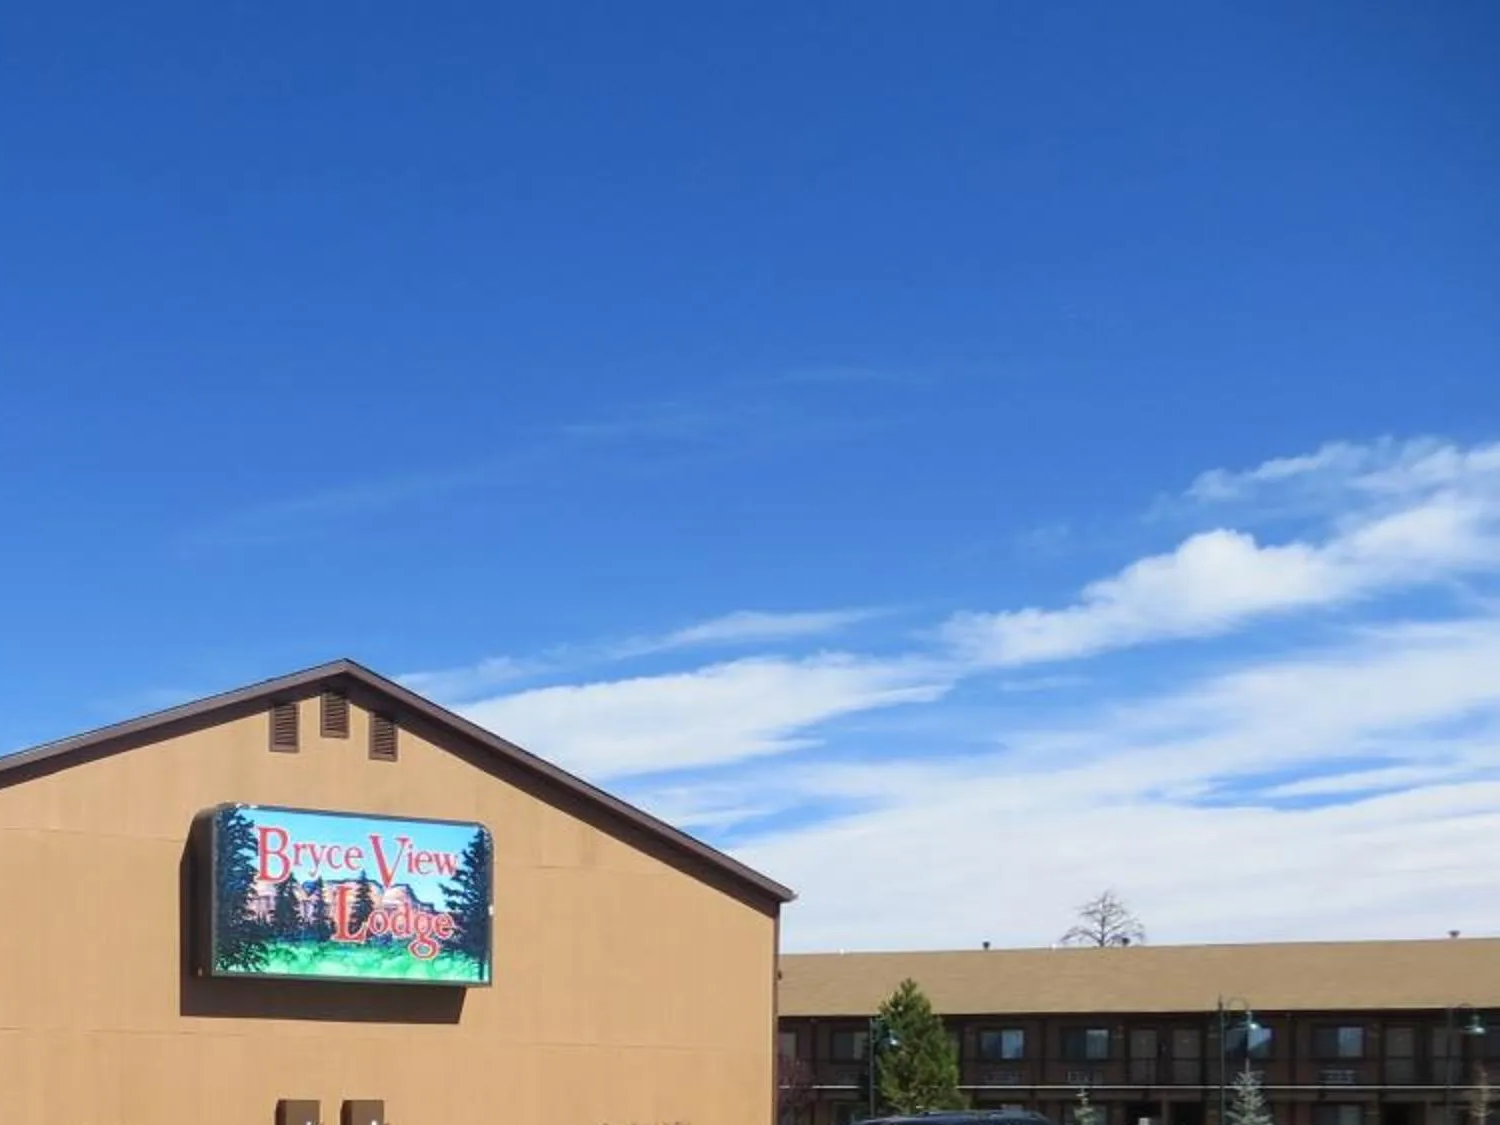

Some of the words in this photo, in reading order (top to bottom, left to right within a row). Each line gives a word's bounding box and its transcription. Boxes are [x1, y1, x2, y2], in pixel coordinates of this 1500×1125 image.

[256, 826, 364, 883] Bryce
[369, 834, 457, 888] View
[331, 884, 454, 960] Lodge
